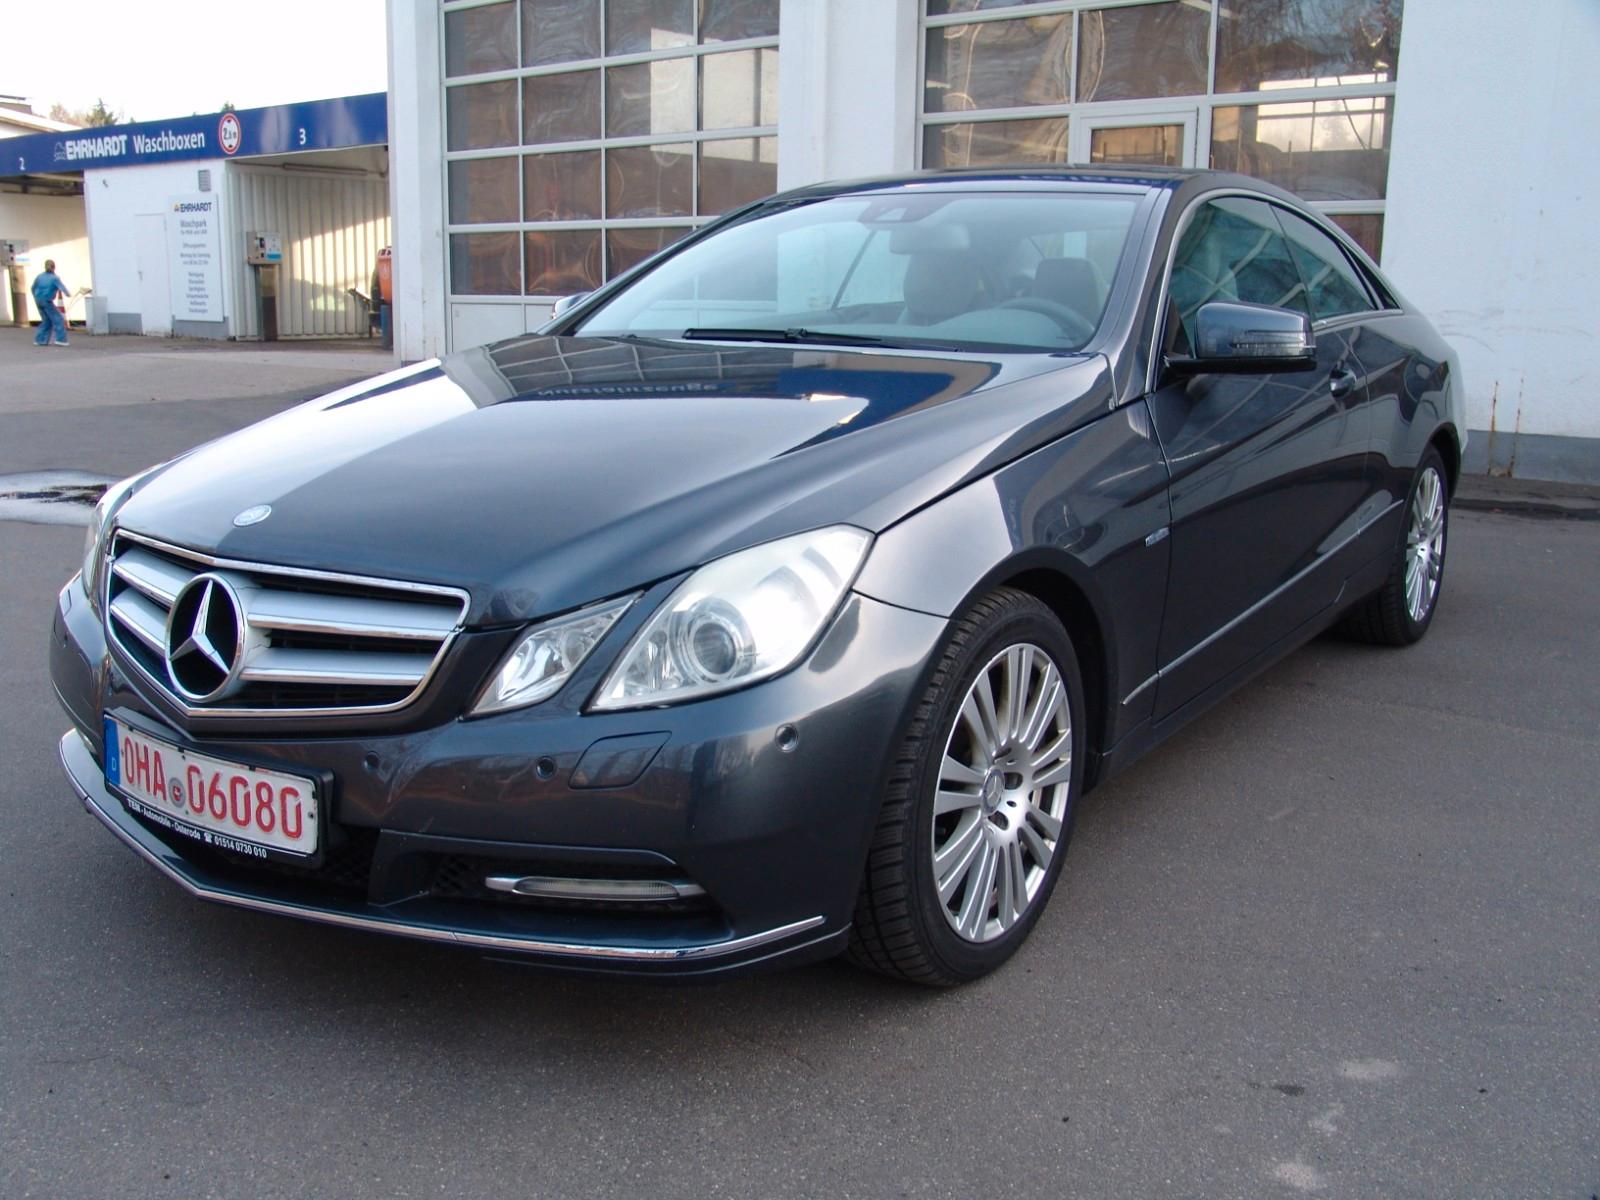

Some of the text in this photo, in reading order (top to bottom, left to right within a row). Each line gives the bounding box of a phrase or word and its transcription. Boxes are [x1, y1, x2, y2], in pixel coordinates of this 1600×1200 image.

[299, 128, 306, 145] 3
[65, 130, 206, 161] EHRHARDT Waschboxen
[18, 156, 26, 171] 2
[180, 202, 212, 213] EHRHARDT
[111, 757, 117, 771] D
[124, 736, 303, 839] OHA 06080
[253, 847, 267, 859] 010
